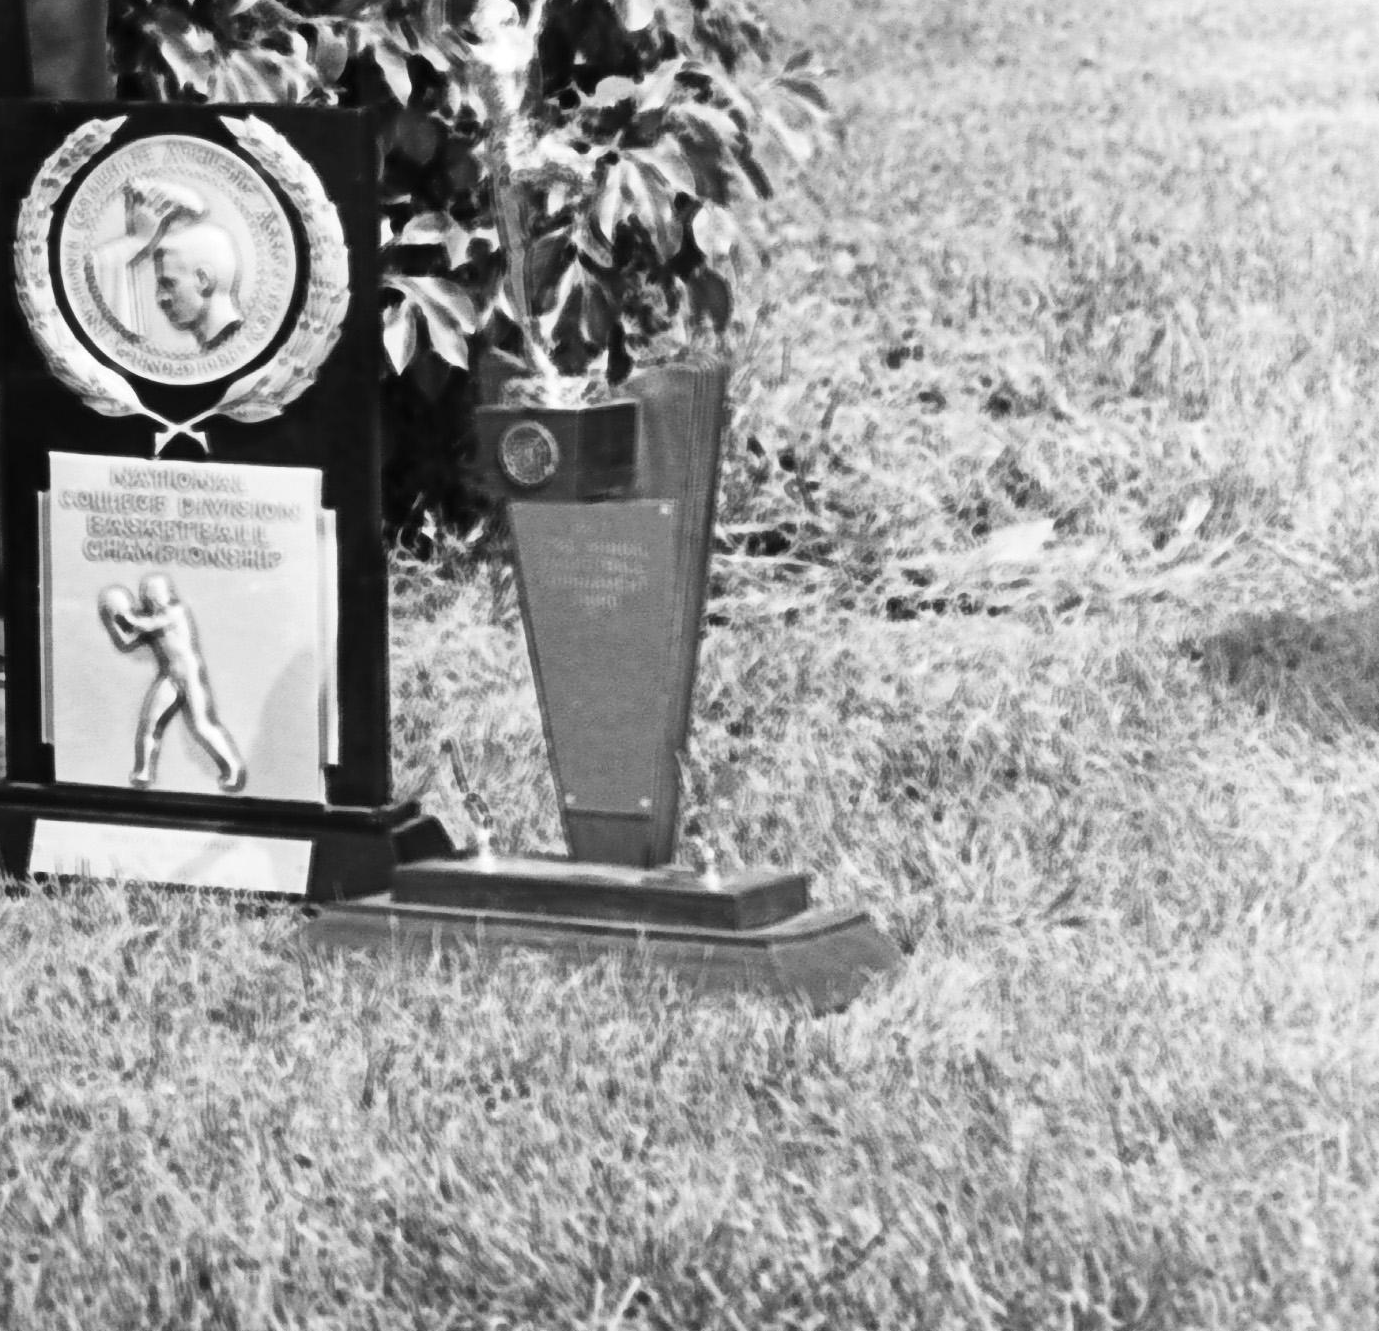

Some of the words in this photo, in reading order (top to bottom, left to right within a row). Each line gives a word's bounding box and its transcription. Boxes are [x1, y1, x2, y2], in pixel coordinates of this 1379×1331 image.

[110, 465, 246, 492] NATIONAL
[58, 489, 169, 514] COLLEGE
[177, 496, 302, 522] DIVISION
[85, 512, 270, 547] BASKETBALL
[82, 537, 283, 571] CHAMPIONSHIP
